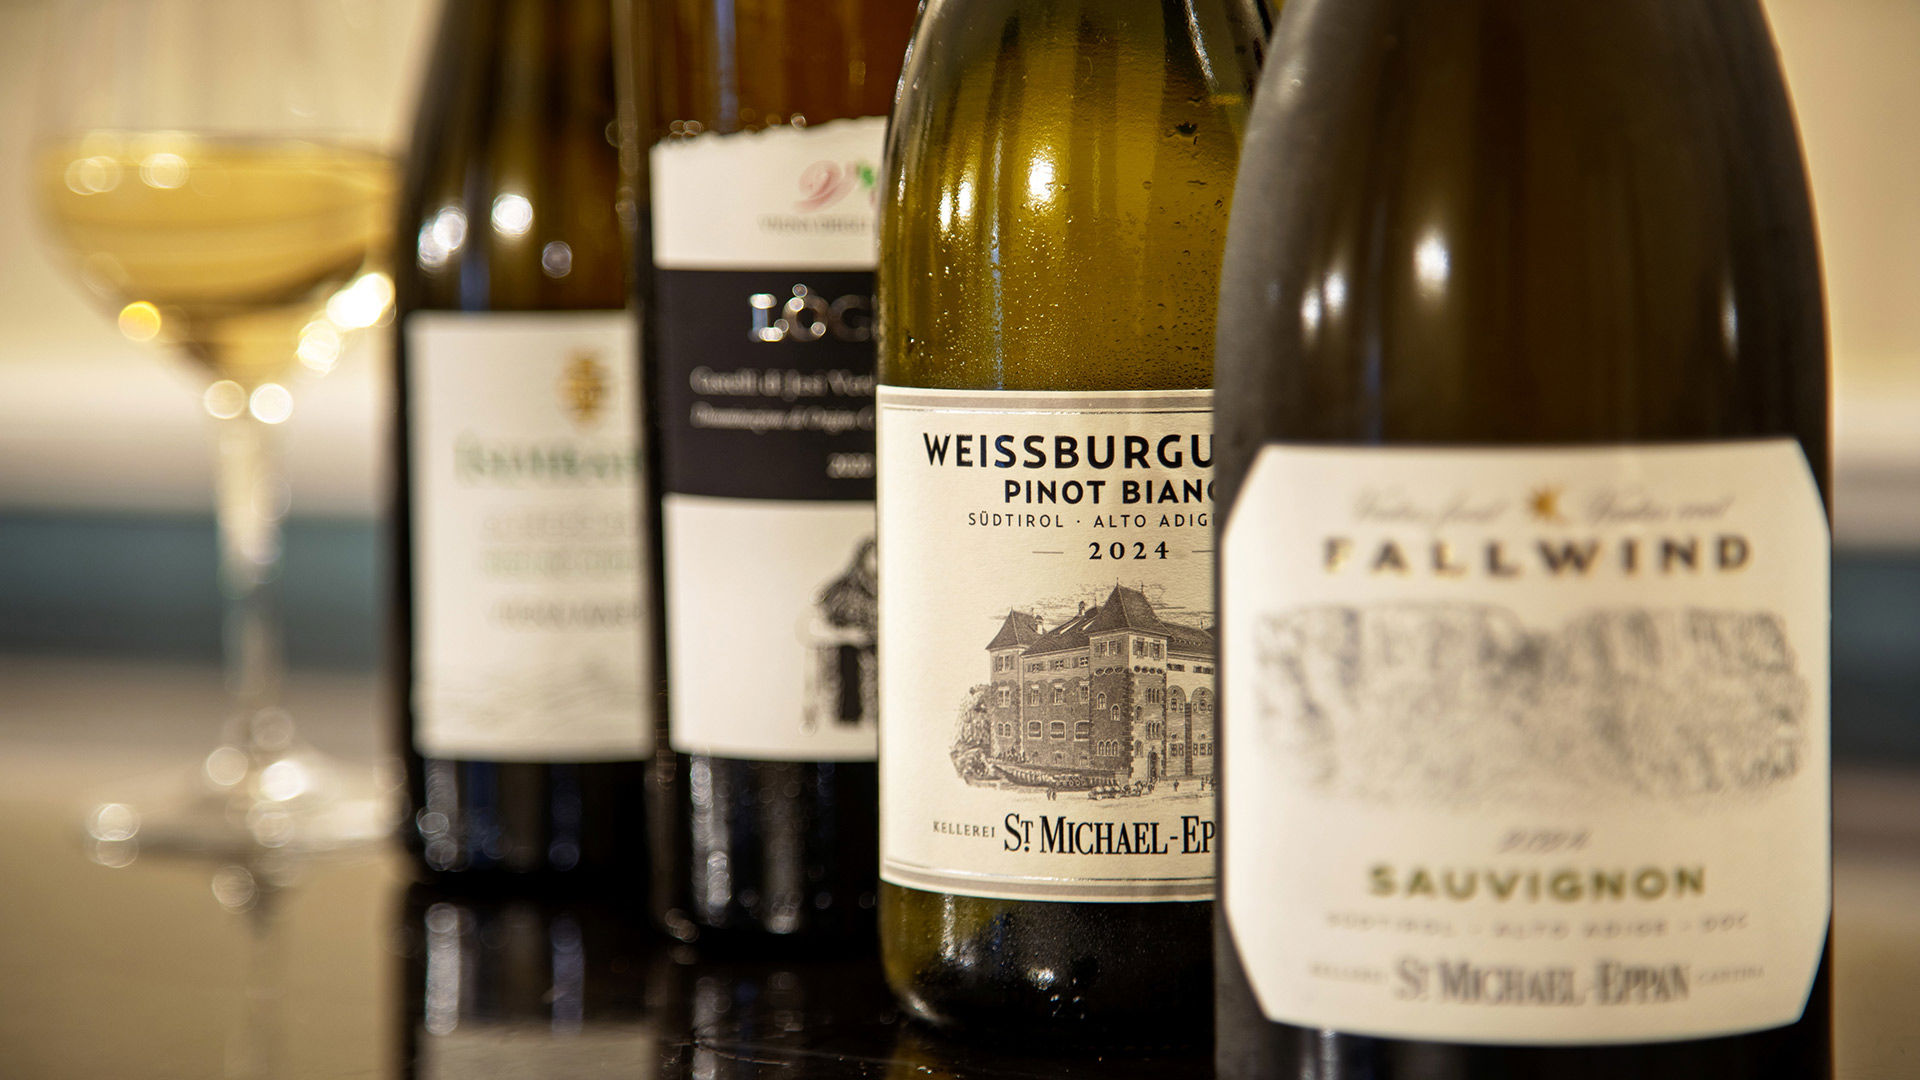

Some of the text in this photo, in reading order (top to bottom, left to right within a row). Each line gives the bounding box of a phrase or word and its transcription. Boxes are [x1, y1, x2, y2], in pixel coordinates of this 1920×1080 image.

[922, 432, 1215, 469] WEISSBURGU
[1004, 480, 1106, 504] PINOT
[968, 510, 1064, 528] SÜDTIROL
[1093, 514, 1146, 528] ALTO
[1088, 541, 1170, 560] 2024
[1323, 533, 1752, 578] FALLWIND
[932, 820, 996, 838] KELLEREI
[1367, 861, 1706, 902] SAUVIGNON
